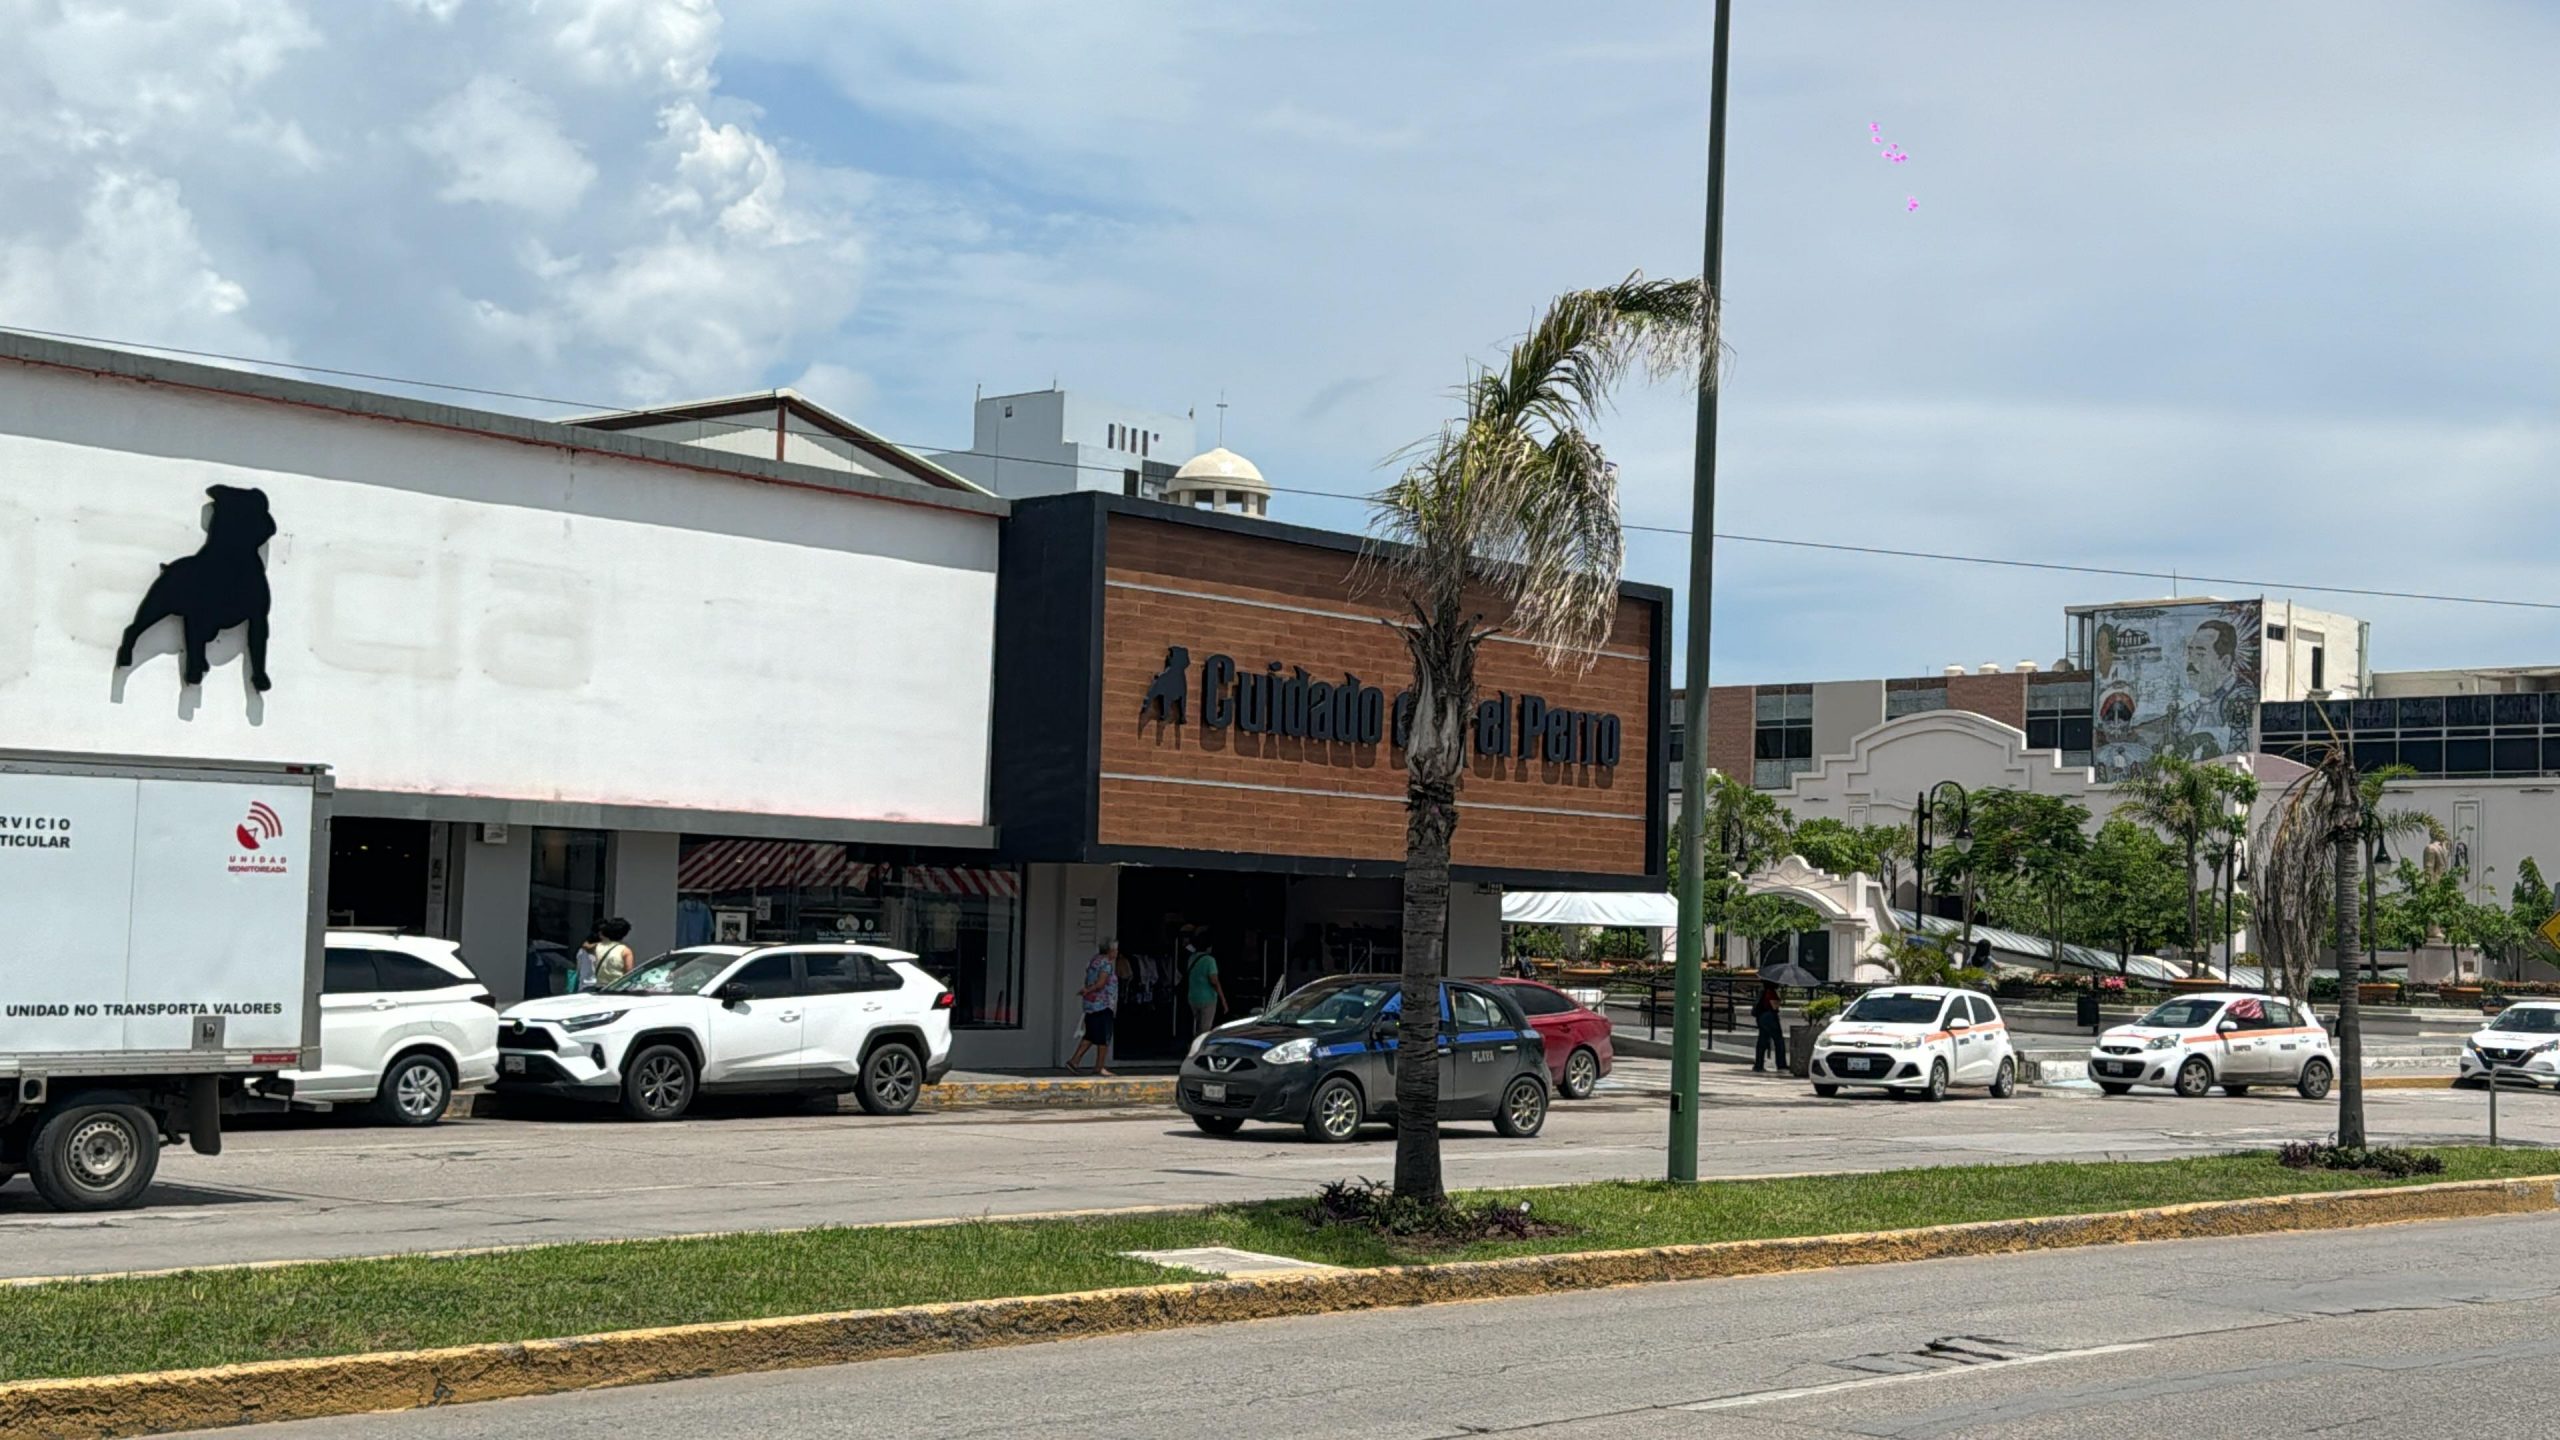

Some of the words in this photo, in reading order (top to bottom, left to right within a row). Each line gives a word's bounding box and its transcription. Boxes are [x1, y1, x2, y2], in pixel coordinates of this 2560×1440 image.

[1202, 654, 1384, 745] Cuidado
[1475, 690, 1512, 758] el
[1517, 694, 1621, 768] Perro
[229, 855, 287, 864] UNIDAD
[228, 865, 287, 873] MONITOREADA
[6, 1004, 69, 1017] UNIDAD
[74, 1004, 98, 1016] NO
[103, 1003, 208, 1016] TRANSPORTA
[213, 1003, 282, 1015] VALORES
